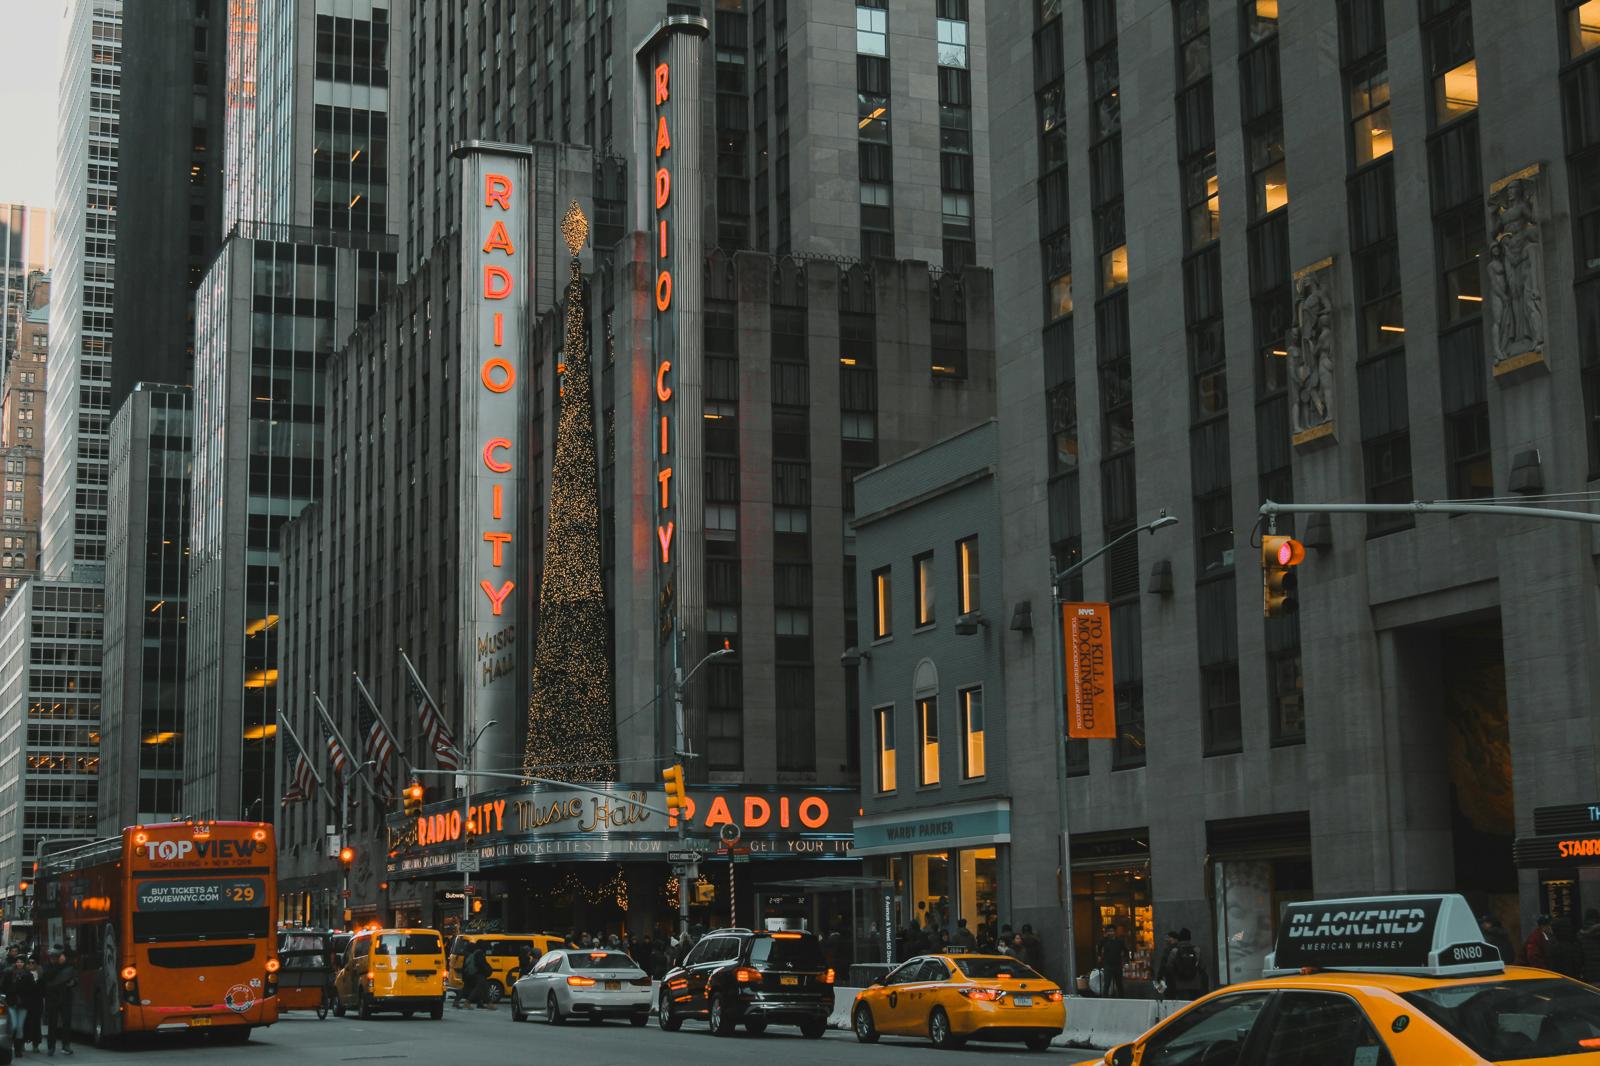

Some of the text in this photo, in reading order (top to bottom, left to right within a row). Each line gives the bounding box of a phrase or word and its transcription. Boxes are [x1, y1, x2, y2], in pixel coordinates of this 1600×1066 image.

[656, 63, 672, 312] RADIO
[480, 173, 516, 617] RADIO CITY
[656, 360, 673, 563] CITY
[1078, 608, 1094, 616] NYC
[478, 625, 516, 662] MUSIC
[1090, 616, 1105, 696] TO KILL A
[482, 653, 515, 688] HALL
[1078, 617, 1095, 730] MOCKINGBIRD
[417, 809, 461, 847] RADIO
[466, 799, 506, 835] CITY
[513, 797, 583, 833] Music
[577, 790, 651, 833] Hall
[193, 825, 211, 835] 334
[886, 821, 954, 841] WARBY PARKER
[497, 845, 509, 857] CITY
[514, 841, 592, 855] ROCKETTES
[629, 840, 661, 851] NOW
[750, 840, 775, 851] GET
[787, 840, 823, 852] YOUR
[142, 893, 219, 904] TOPVIEWNYC.COM
[151, 885, 219, 895] BUY TICKETS AT
[1289, 908, 1425, 938] BLACKENED
[886, 942, 892, 950] 50
[1299, 940, 1404, 951] AMERICAN WHISKEY
[1453, 945, 1482, 960] 8N80
